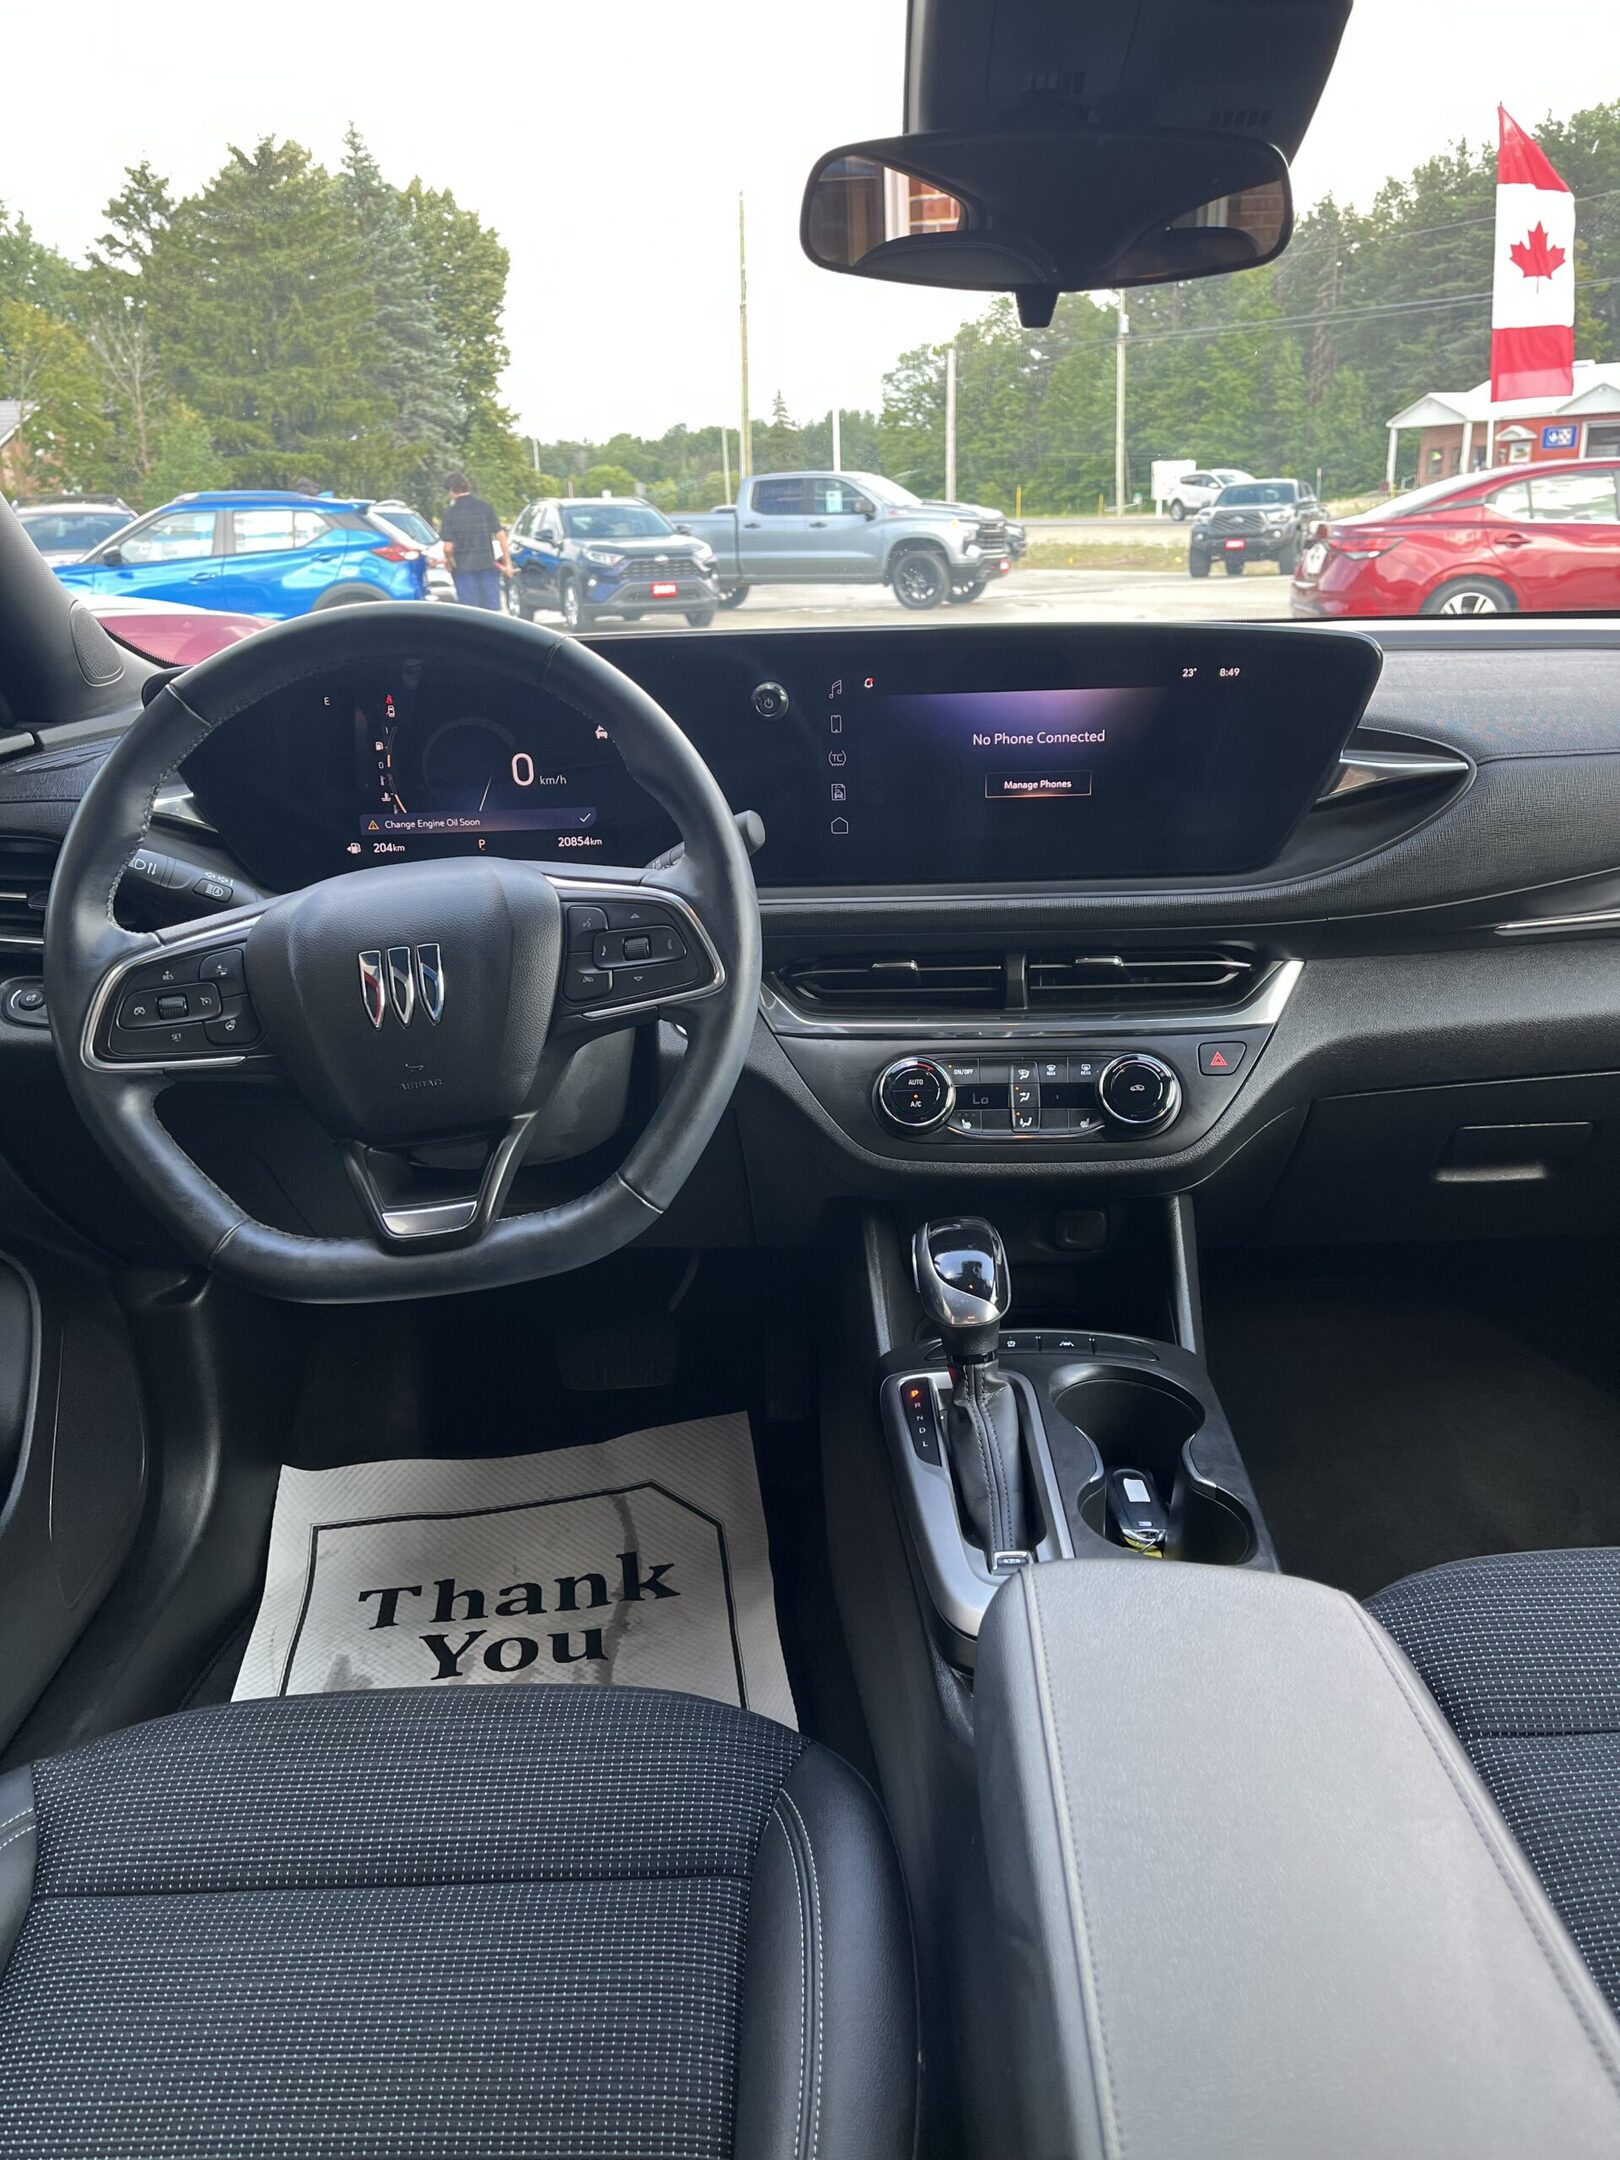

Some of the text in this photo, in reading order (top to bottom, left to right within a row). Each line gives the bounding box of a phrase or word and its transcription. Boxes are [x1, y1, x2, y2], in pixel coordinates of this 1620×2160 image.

[1219, 667, 1240, 677] 8:49
[972, 729, 1106, 746] No Phone Connected
[831, 753, 843, 763] TC
[511, 752, 567, 787] 0 km/h
[1003, 779, 1072, 791] Manage Phones
[384, 818, 481, 830] Change Engine Oil Soon
[478, 839, 486, 850] P
[953, 1068, 974, 1076] ON/OFF
[911, 1389, 920, 1398] P
[922, 1440, 929, 1448] L
[358, 1551, 681, 1631] Thank
[418, 1627, 609, 1680] You
